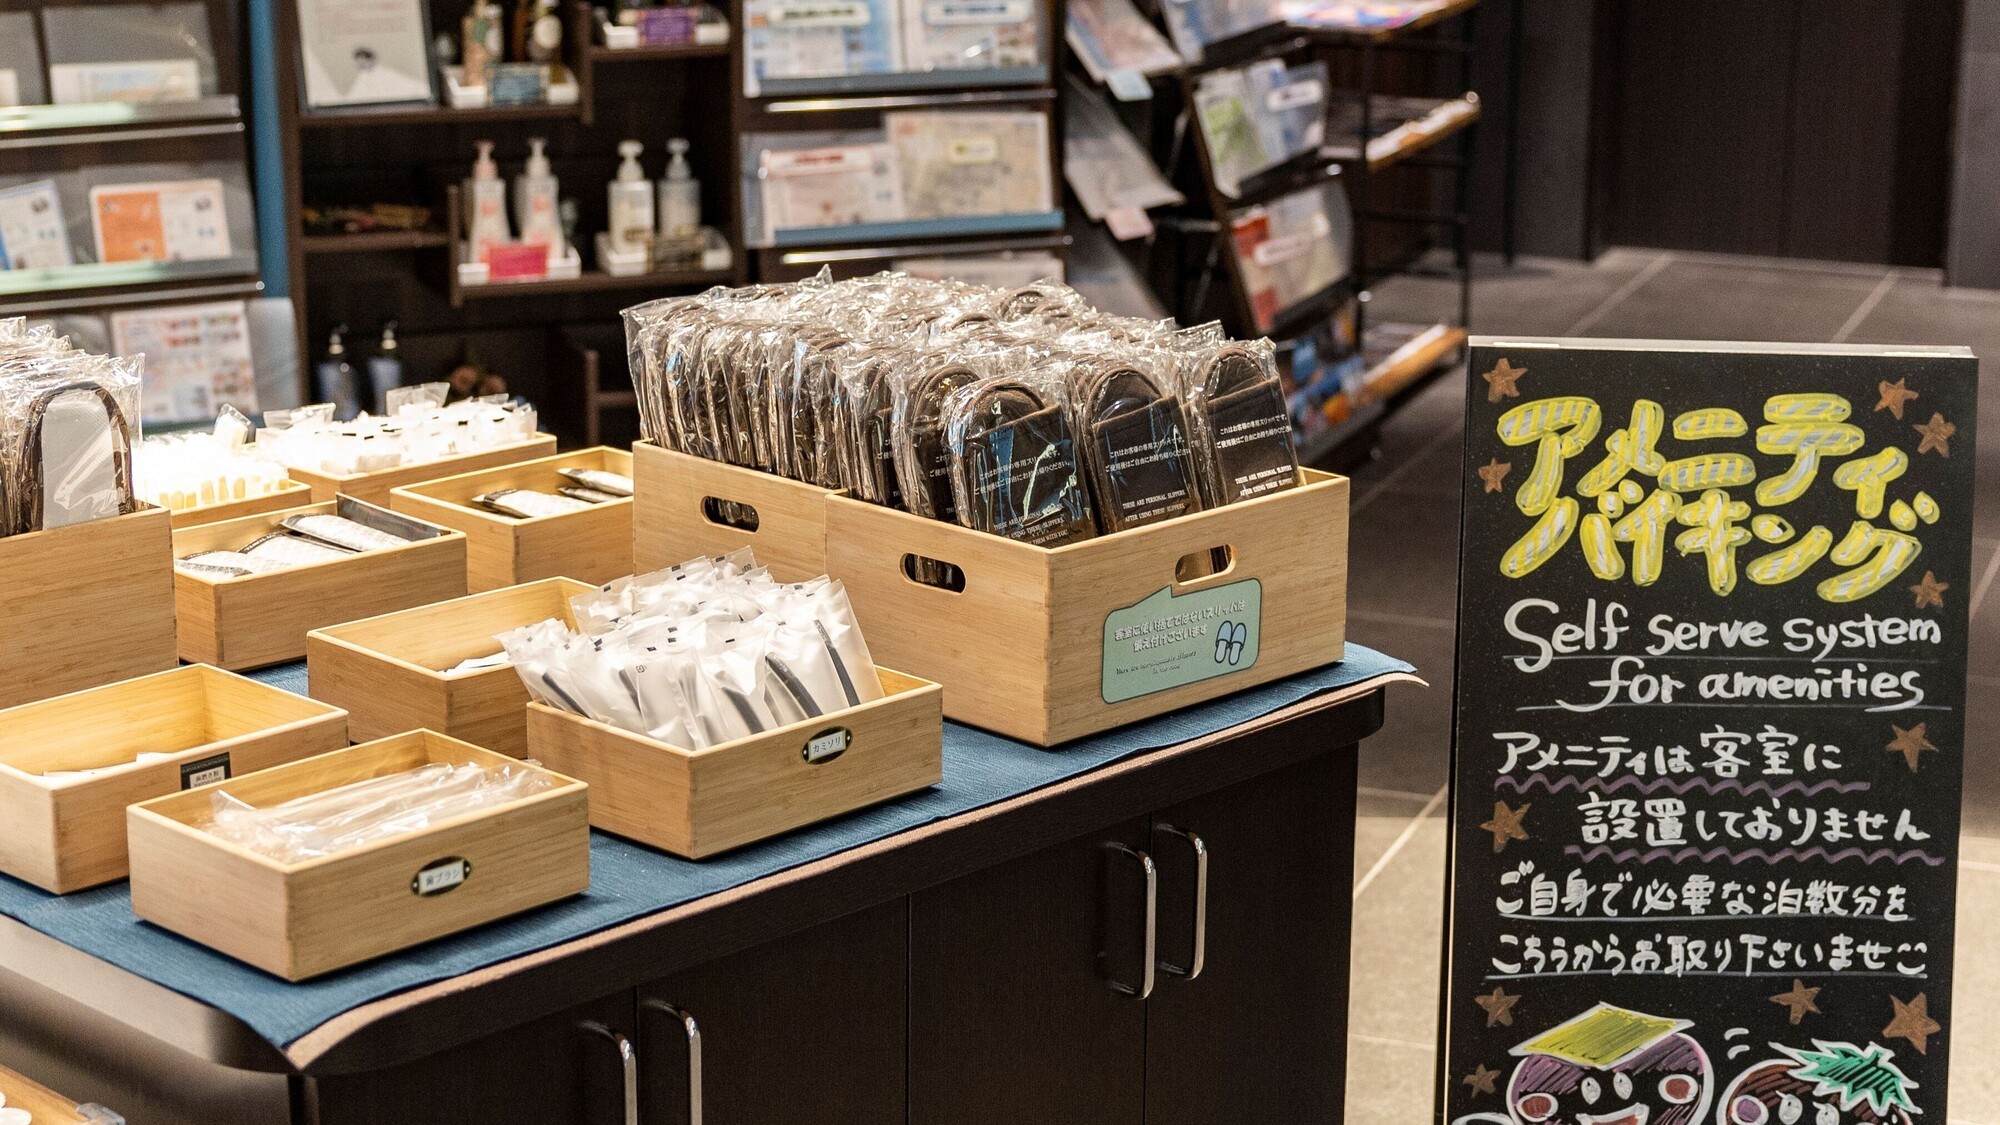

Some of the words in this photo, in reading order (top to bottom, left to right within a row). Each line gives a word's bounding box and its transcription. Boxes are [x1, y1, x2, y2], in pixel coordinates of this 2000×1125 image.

[1498, 392, 1909, 519] アメニティ
[1499, 480, 1940, 603] バイキング
[1503, 598, 1630, 673] Self
[1645, 613, 1769, 656] serve
[1782, 613, 1941, 663] system
[1556, 656, 1685, 711] for
[1699, 663, 1923, 711] amenities
[812, 736, 841, 754] カミソリ
[1492, 725, 1842, 778] アメニティは客室に
[1578, 791, 1930, 846] 設置しておりません
[1496, 860, 1909, 922] ご自身で必要な泊数分を
